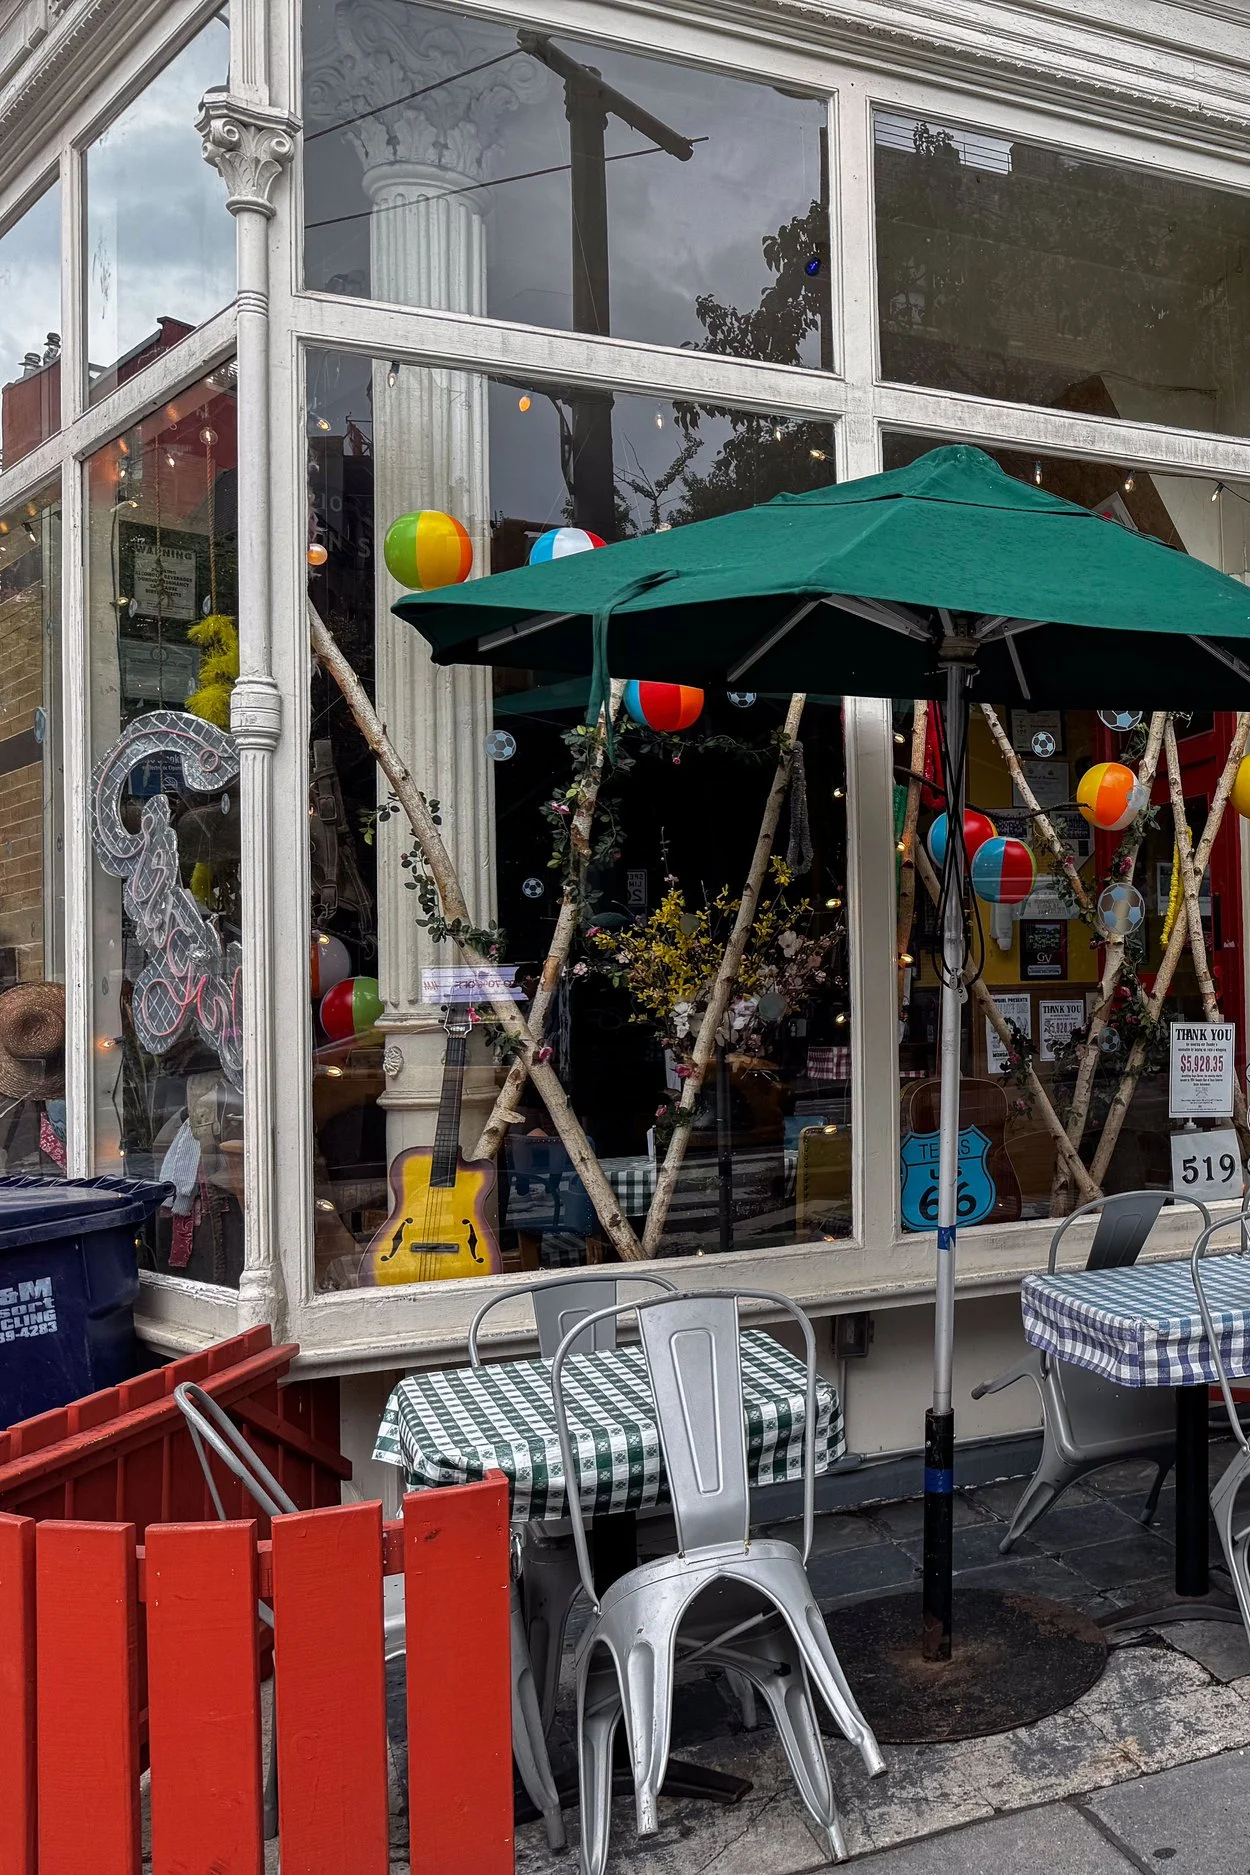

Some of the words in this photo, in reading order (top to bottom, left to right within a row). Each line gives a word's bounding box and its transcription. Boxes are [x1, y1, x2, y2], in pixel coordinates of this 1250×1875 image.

[1043, 1005, 1063, 1014] THANK
[1066, 1005, 1081, 1013] YOU
[1175, 1028, 1208, 1041] THANK
[1210, 1028, 1232, 1041] YOU
[1180, 1053, 1224, 1074] $5,928.35
[919, 1139, 971, 1159] TES
[1182, 1153, 1236, 1184] 519
[919, 1181, 977, 1221] 66
